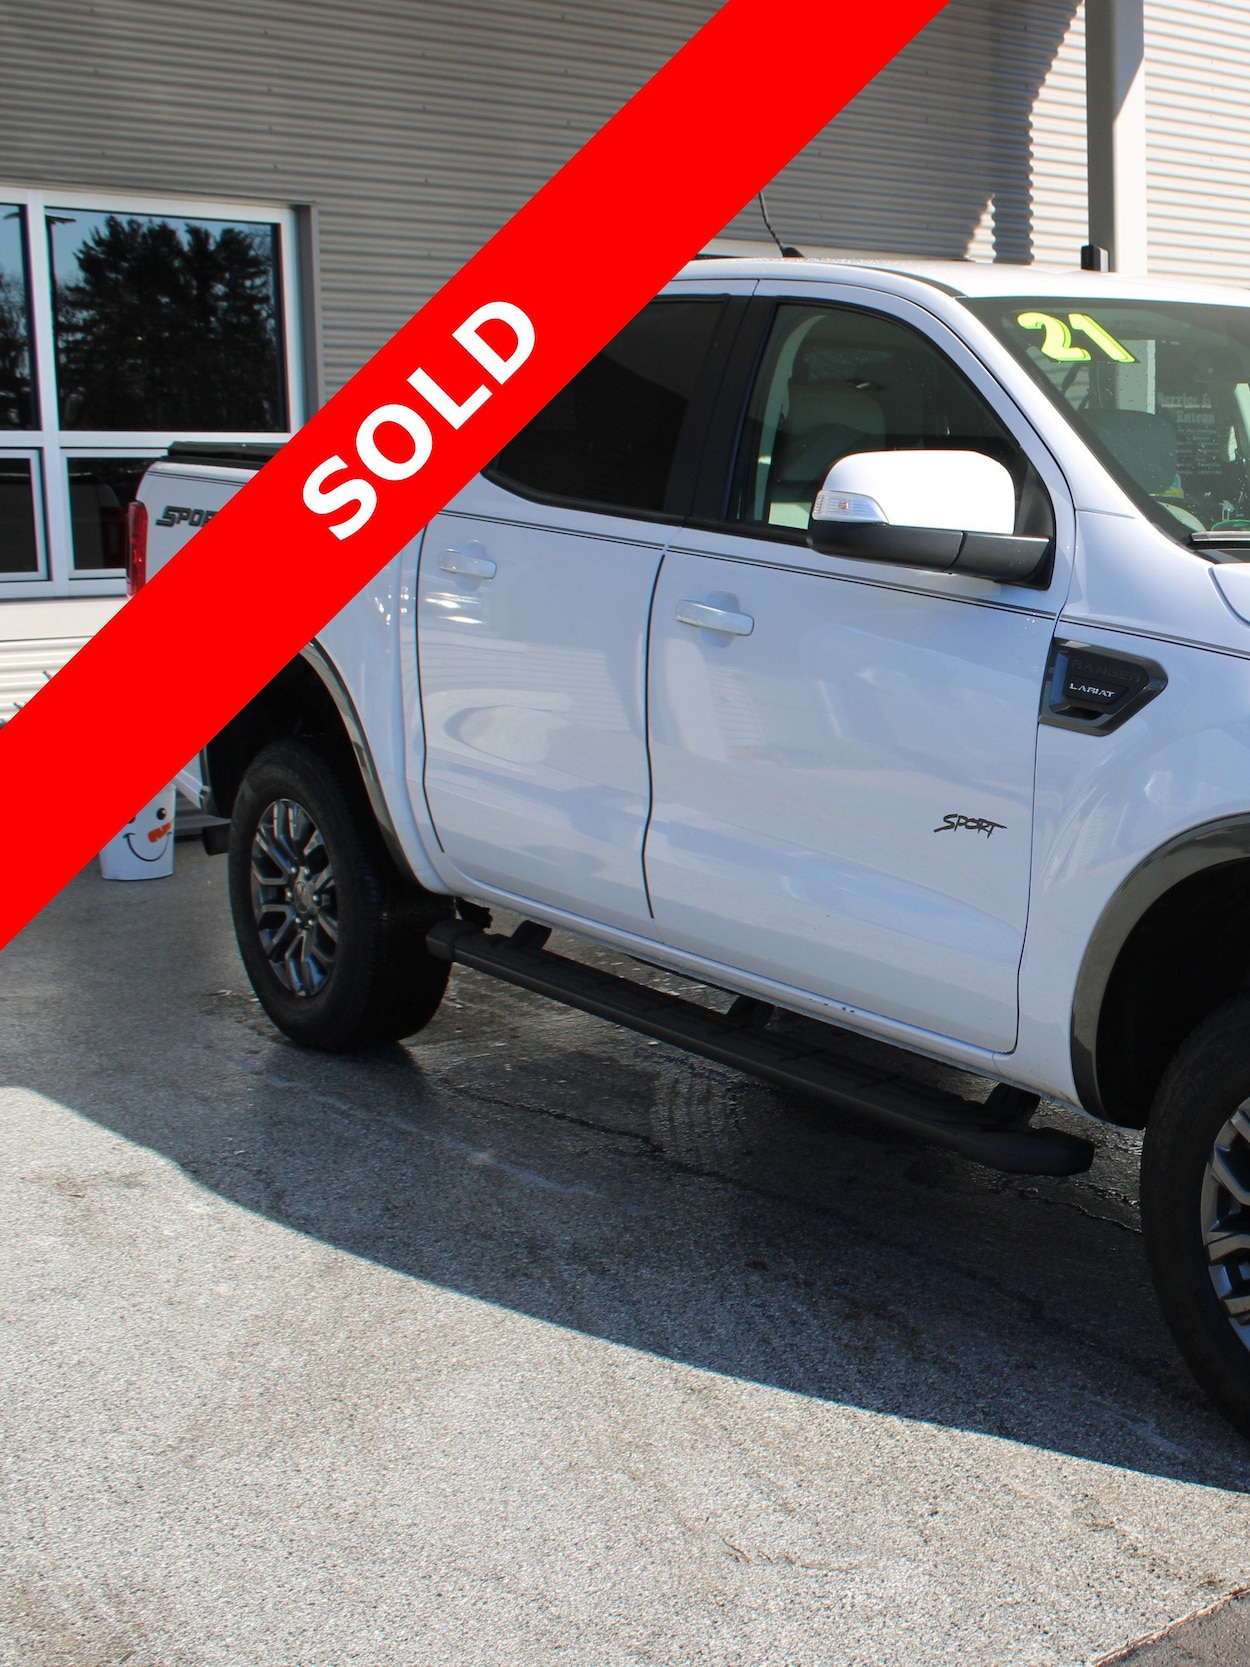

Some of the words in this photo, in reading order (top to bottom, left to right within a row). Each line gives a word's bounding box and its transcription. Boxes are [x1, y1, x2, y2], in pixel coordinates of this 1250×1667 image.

[1017, 311, 1136, 363] 21
[1069, 682, 1115, 698] LARIAT
[933, 813, 1008, 839] SPORT
